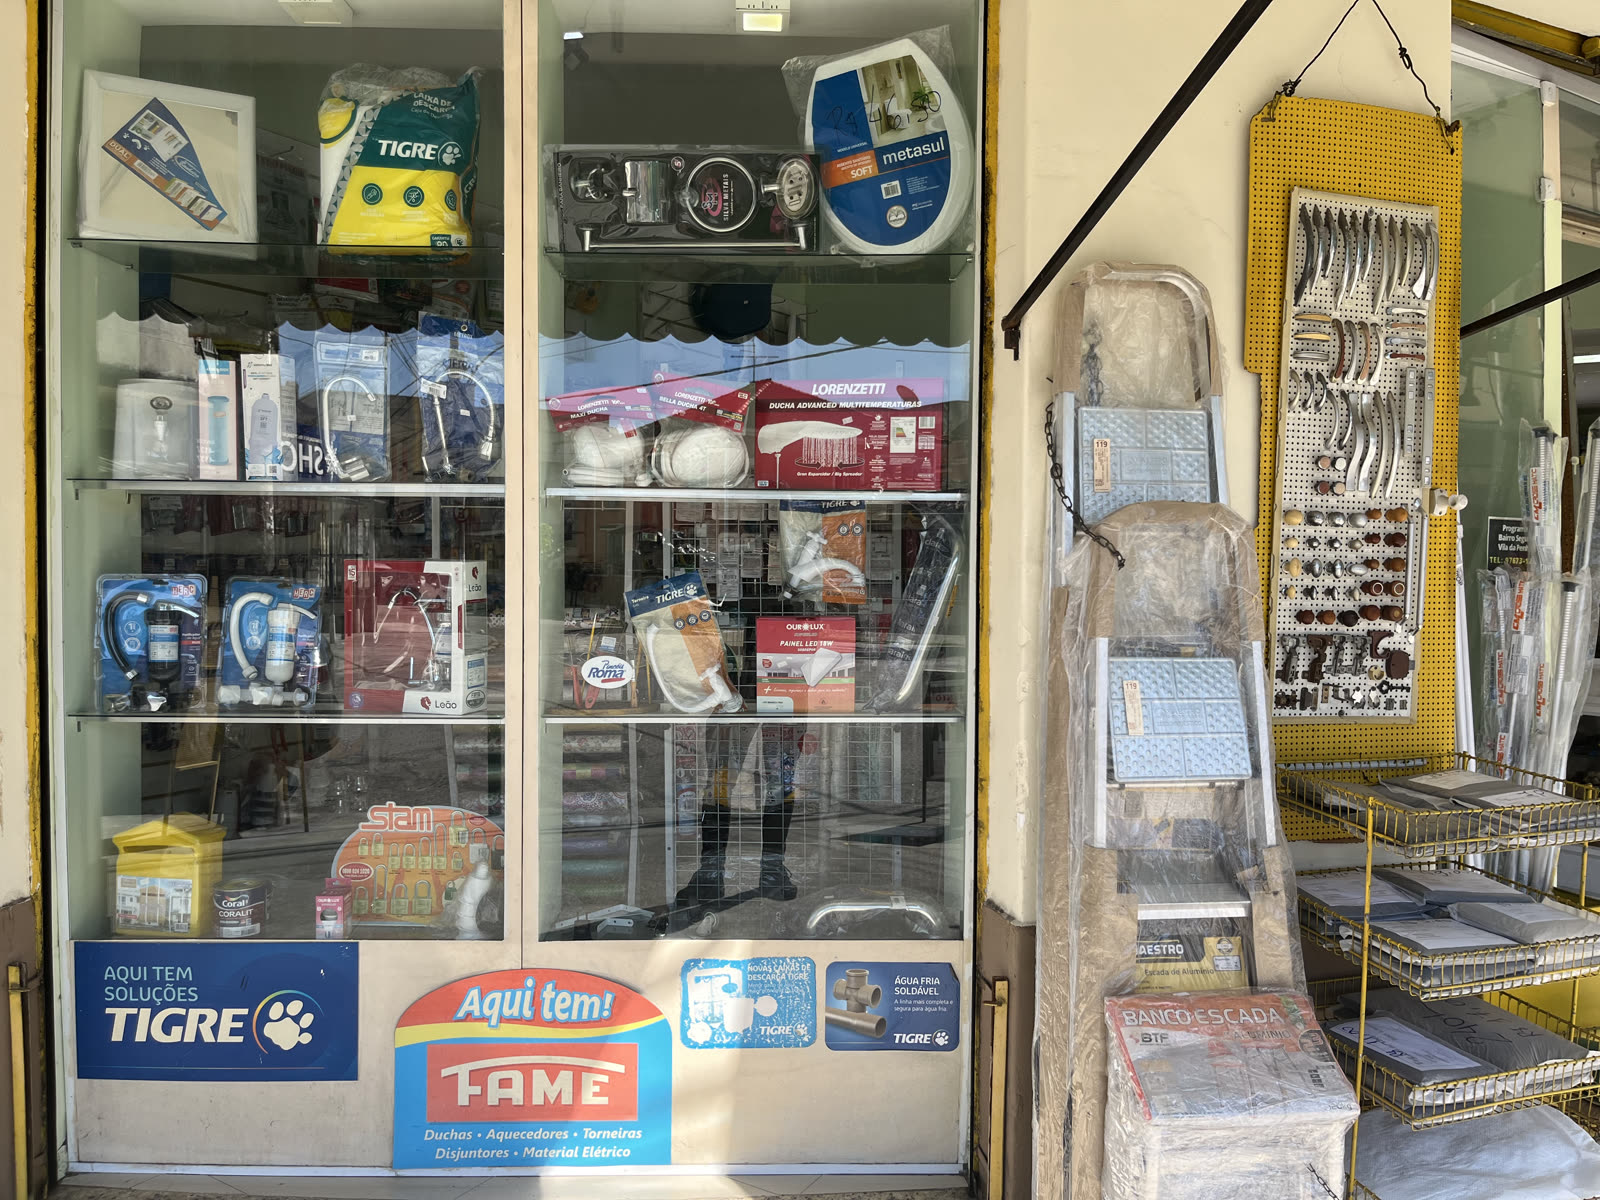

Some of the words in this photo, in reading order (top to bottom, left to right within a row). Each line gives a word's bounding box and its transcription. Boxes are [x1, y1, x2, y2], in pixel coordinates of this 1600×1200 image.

[109, 141, 130, 160] DUAL
[378, 139, 440, 160] TIGRE
[883, 136, 945, 165] metasul
[850, 165, 873, 179] SOFT
[812, 382, 887, 396] LORENZETTI
[677, 400, 698, 410] DUCHA
[796, 401, 837, 409] ADVANCED
[838, 400, 922, 409] MULTITEMPERATURAS
[586, 407, 608, 416] DUCHA
[1502, 524, 1528, 534] Program
[1498, 533, 1515, 541] Bairro
[1515, 534, 1528, 544] Segu
[1498, 543, 1508, 551] Vila
[1509, 543, 1516, 551] da
[171, 584, 197, 598] HERC
[293, 587, 316, 600] HERC
[468, 584, 482, 592] Leão
[655, 588, 685, 604] TIGRE
[587, 667, 626, 679] Roma
[1125, 682, 1137, 690] 119
[434, 699, 458, 709] Leão
[222, 900, 245, 908] Coral
[218, 908, 254, 918] CORALIT
[1136, 944, 1184, 955] AESTRO
[104, 966, 148, 983] AQUI
[153, 966, 193, 981] TEM
[894, 975, 919, 985] ÁGUA
[920, 977, 940, 985] FRIA
[104, 983, 199, 1006] SOLUÇÕES
[894, 986, 939, 996] SOLDÁVEL
[455, 978, 534, 1026] Aqui
[541, 981, 615, 1021] tem!
[1121, 1009, 1192, 1026] BANCO
[1194, 1007, 1285, 1025] ESCADA
[105, 1007, 249, 1043] TIGRE
[760, 1026, 794, 1036] TIGRE
[893, 1033, 932, 1044] TIGRE
[441, 1055, 625, 1106] FAME
[424, 1129, 473, 1141] Duchas
[486, 1128, 569, 1143] Aquecedores
[583, 1128, 642, 1140] Torneiras
[435, 1147, 509, 1162] Disjuntores
[523, 1146, 579, 1158] Material
[582, 1146, 631, 1158] Elétrico
